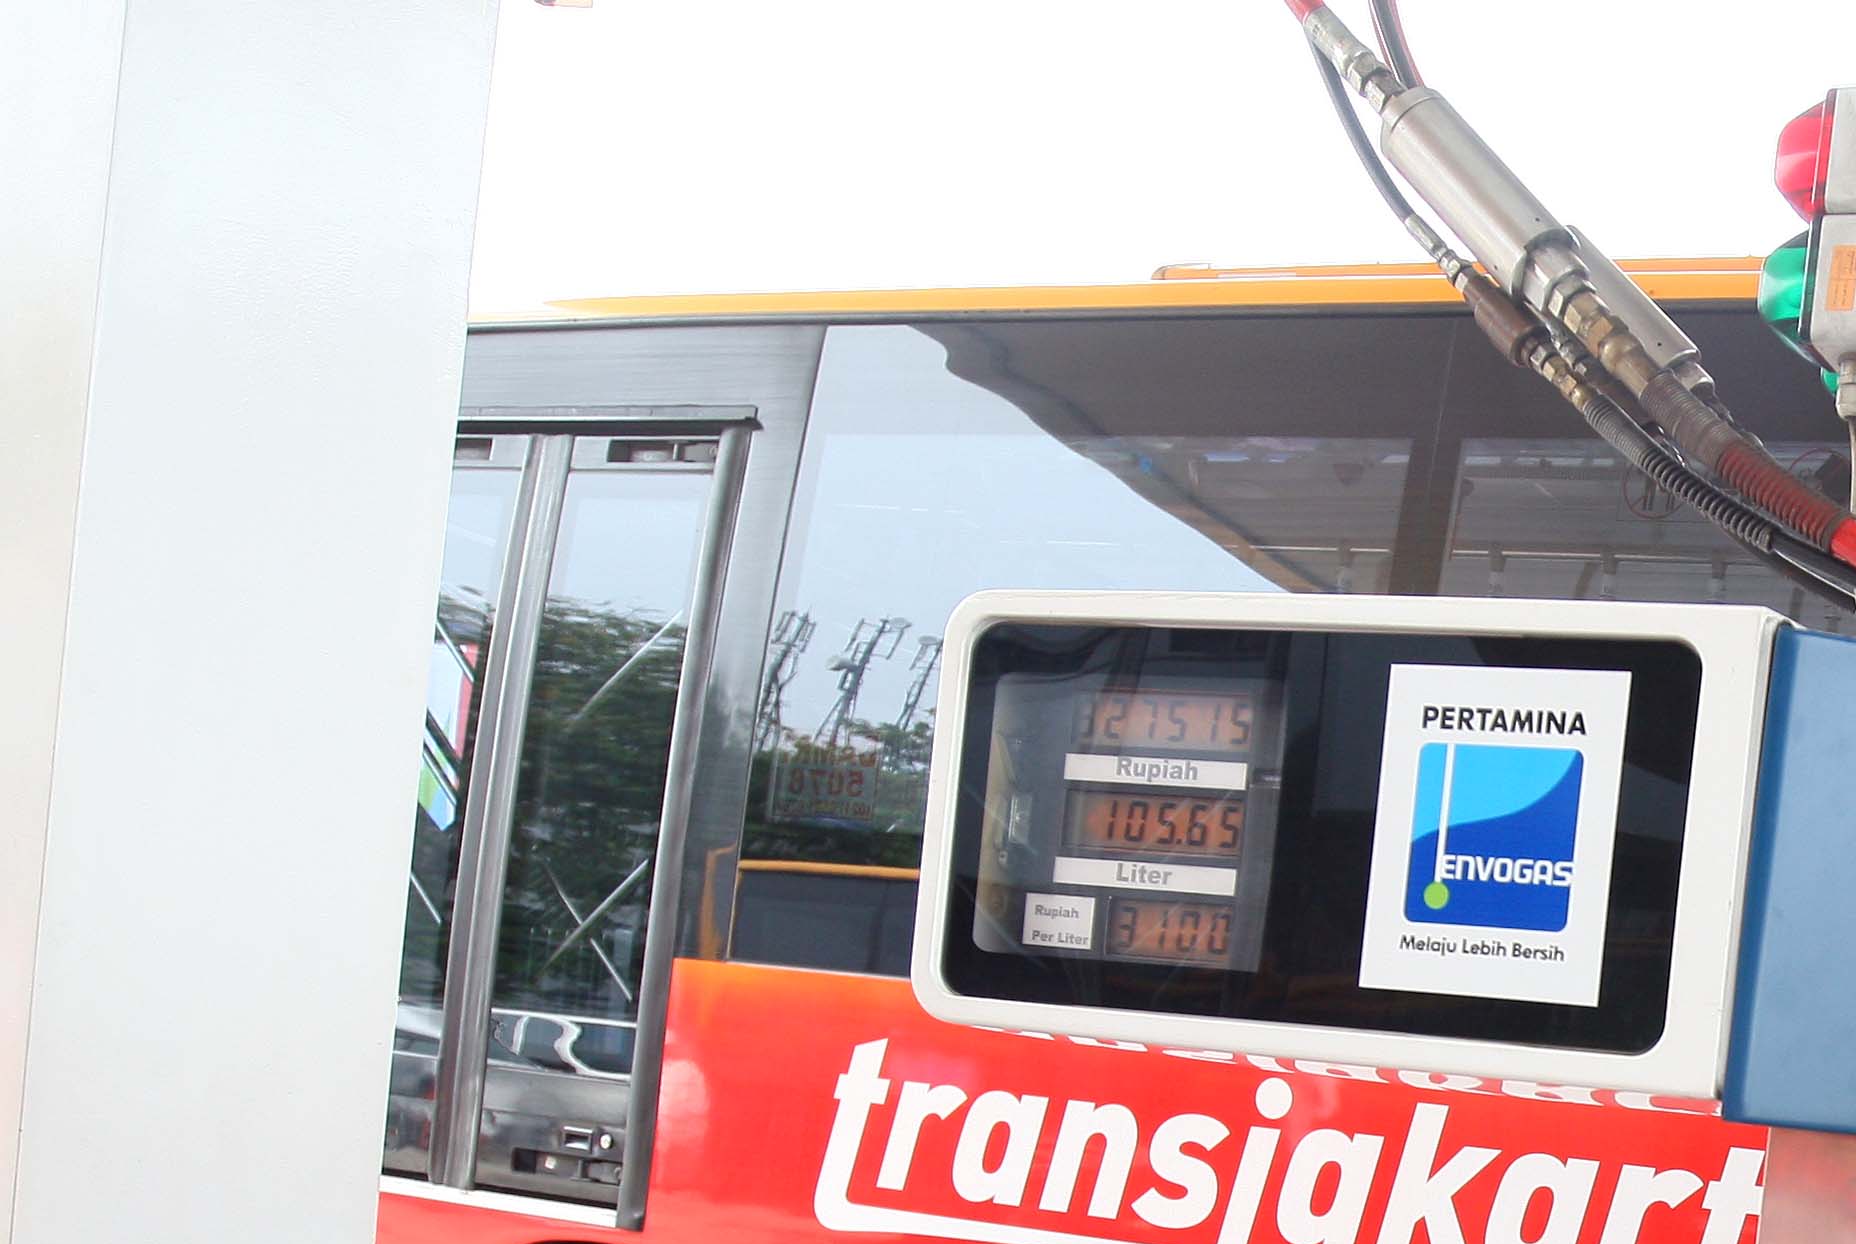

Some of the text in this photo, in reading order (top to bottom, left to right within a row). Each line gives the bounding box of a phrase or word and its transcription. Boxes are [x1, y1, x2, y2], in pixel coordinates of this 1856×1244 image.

[1421, 706, 1586, 736] PERTAMINA
[1115, 756, 1199, 782] Rupiah
[1105, 799, 1240, 848] 105.65
[1115, 862, 1173, 885] Liter
[1438, 853, 1576, 887] ENVOGAS
[1034, 903, 1080, 921] Rupiah
[1031, 929, 1089, 947] Per Liter
[1118, 905, 1232, 954] 3100
[1399, 934, 1566, 962] Melaju Lebih Bersih
